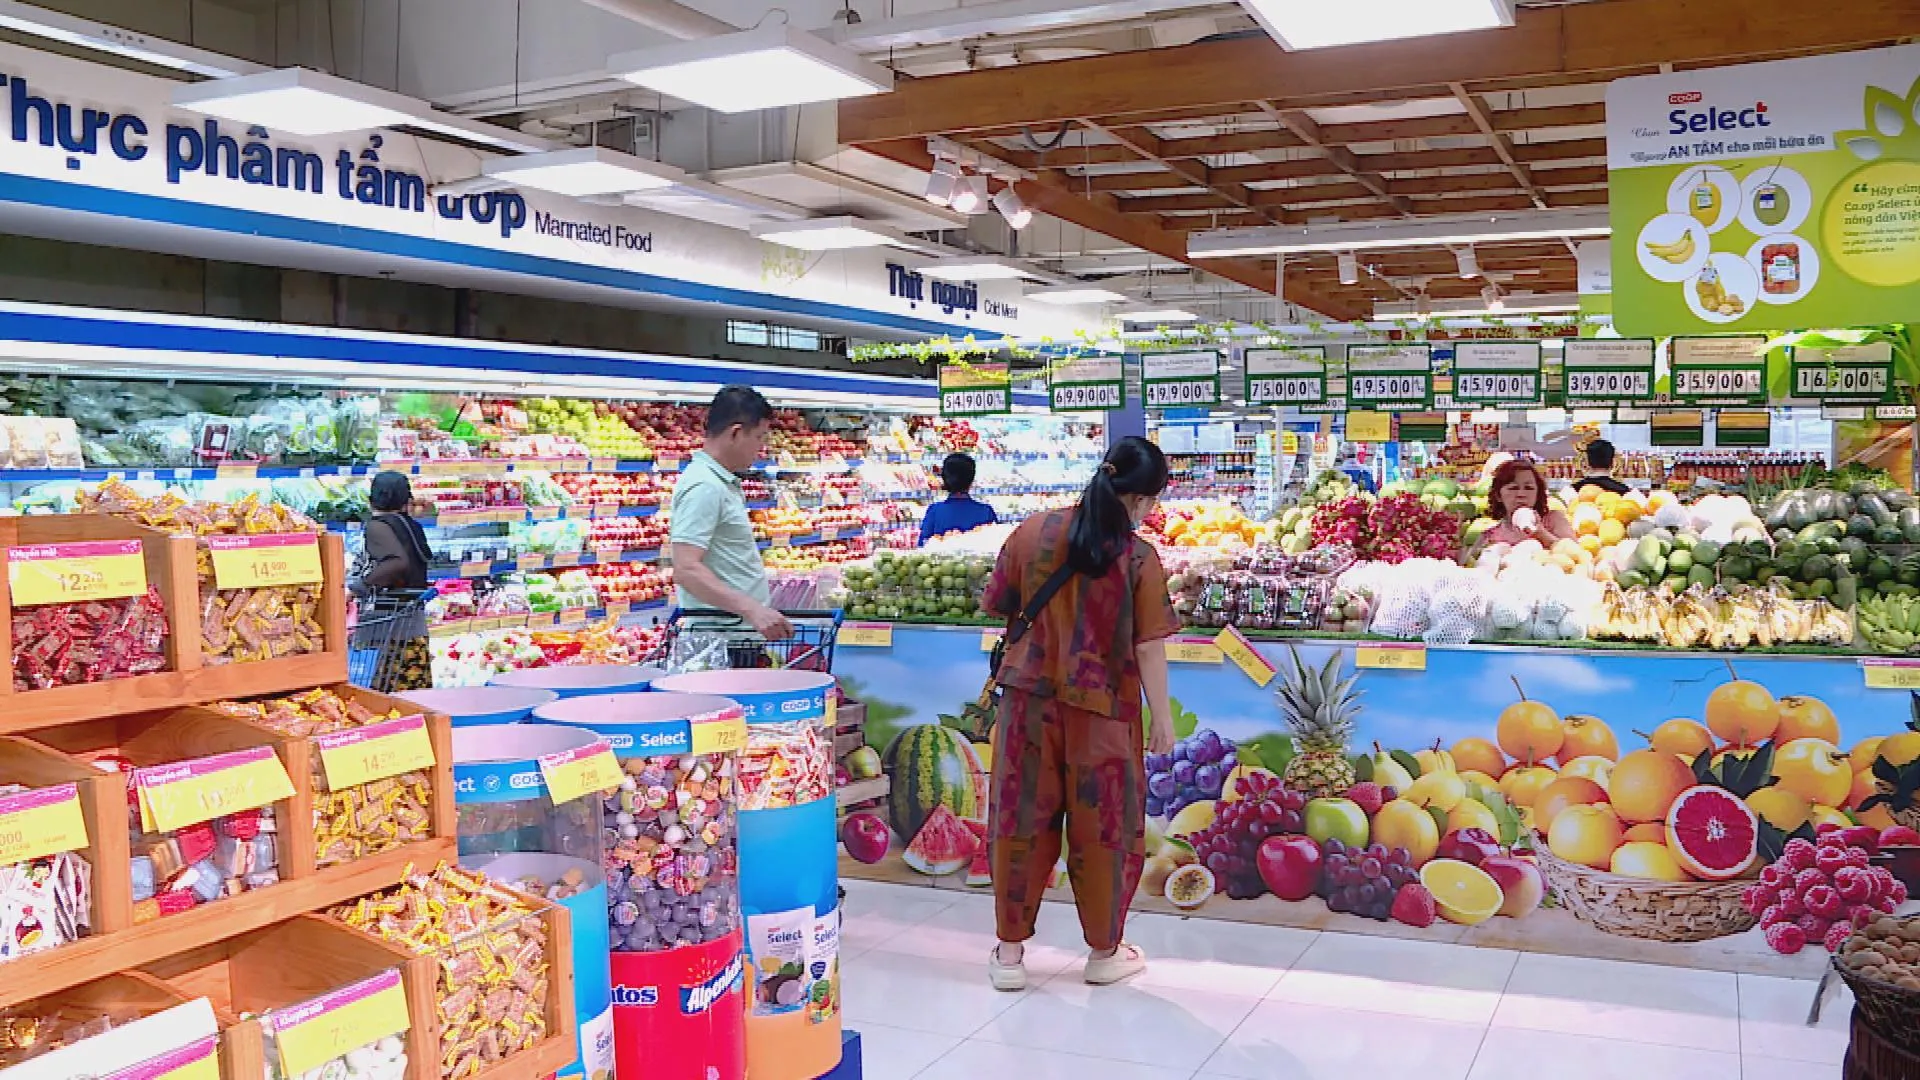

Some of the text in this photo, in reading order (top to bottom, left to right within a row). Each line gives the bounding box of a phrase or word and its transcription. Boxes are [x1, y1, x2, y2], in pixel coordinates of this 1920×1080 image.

[1669, 101, 1771, 134] Select
[0, 74, 148, 170] hực
[336, 134, 425, 213] tẩm
[1668, 145, 1690, 159] AN
[1692, 140, 1724, 157] TÂM
[615, 225, 652, 253] Food
[640, 731, 687, 747] Select
